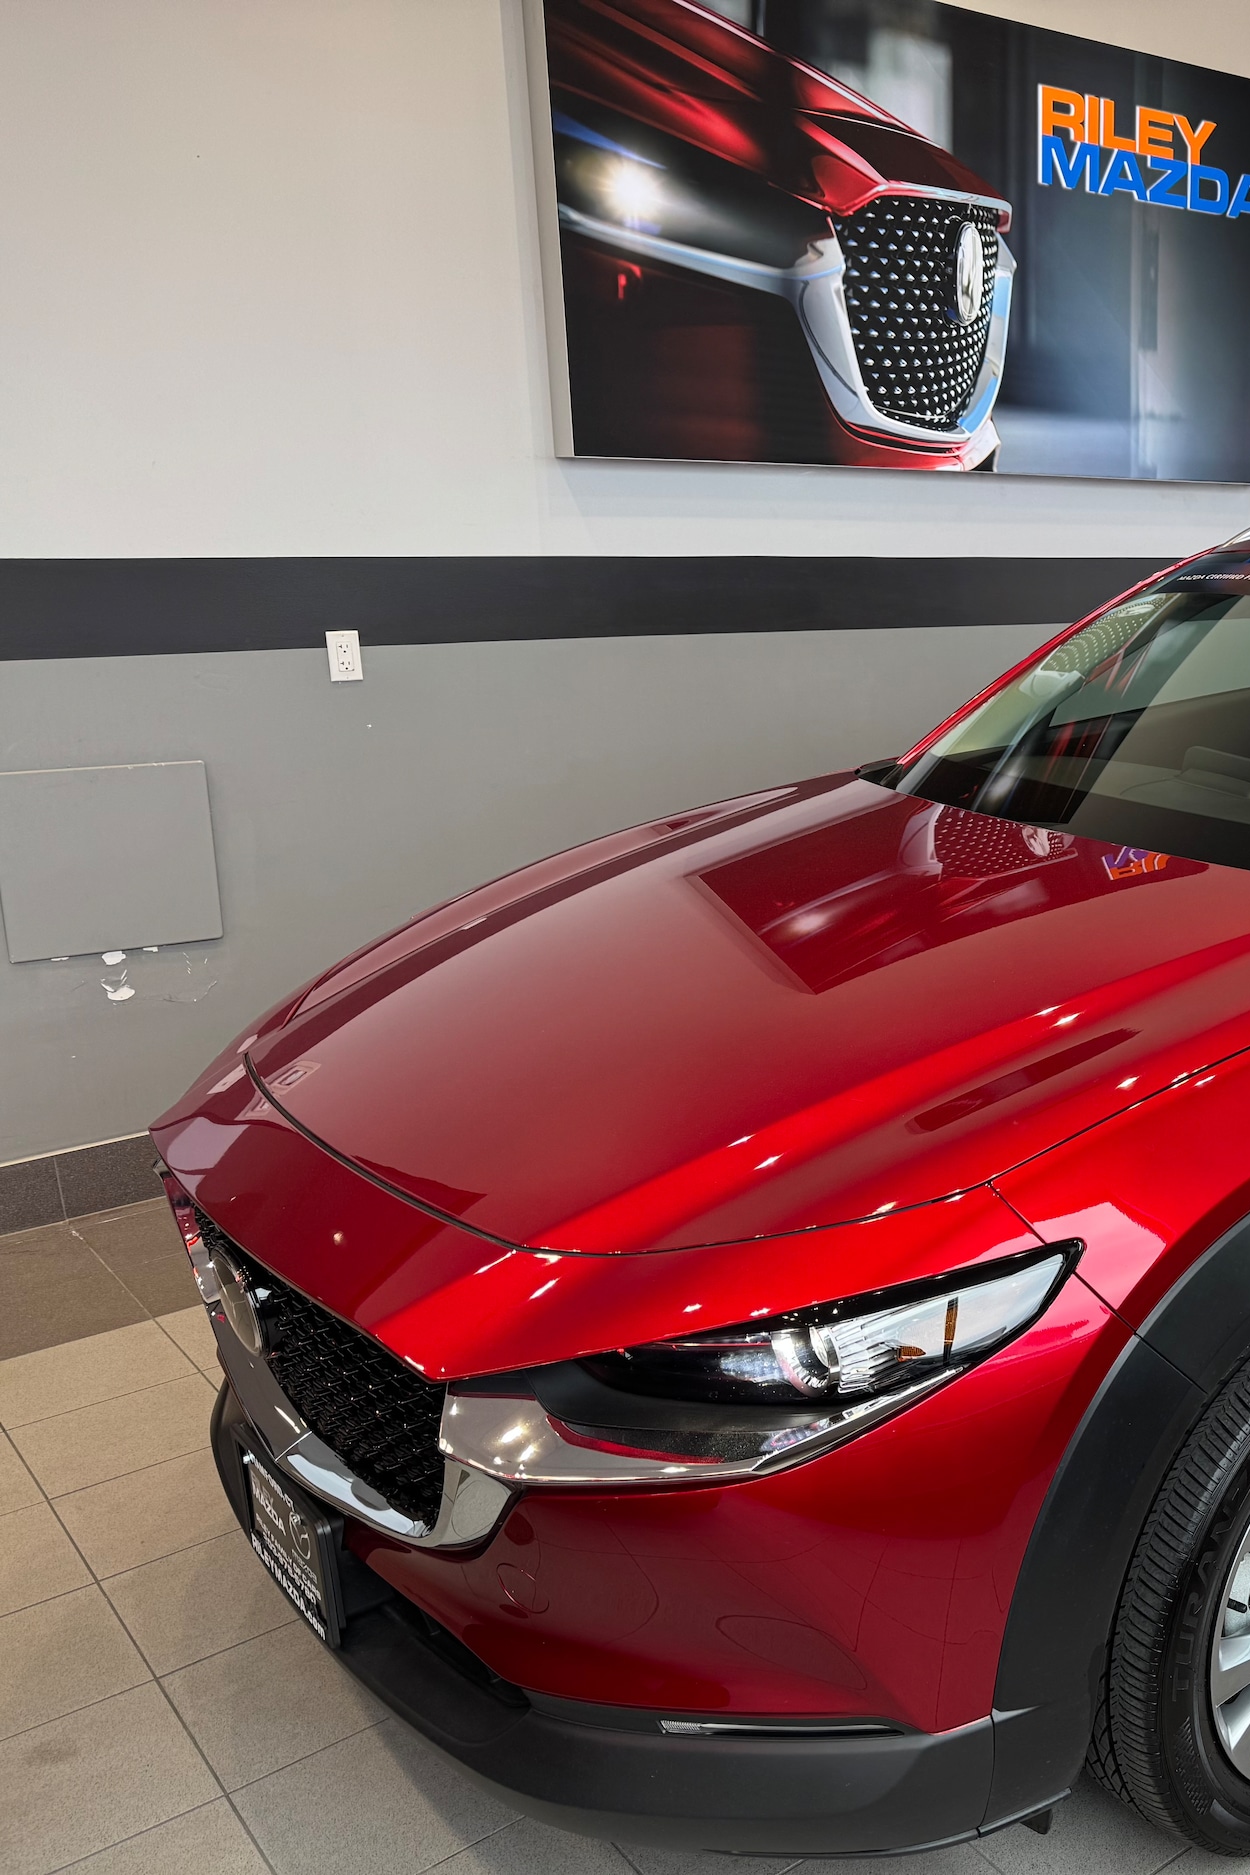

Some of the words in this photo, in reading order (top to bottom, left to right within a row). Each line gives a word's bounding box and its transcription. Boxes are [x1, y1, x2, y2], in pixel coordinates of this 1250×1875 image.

[1038, 83, 1217, 166] RILEY
[251, 1480, 286, 1536] MAZDA
[251, 1532, 326, 1641] RILEYMAZDA.com
[302, 1573, 321, 1601] CARS
